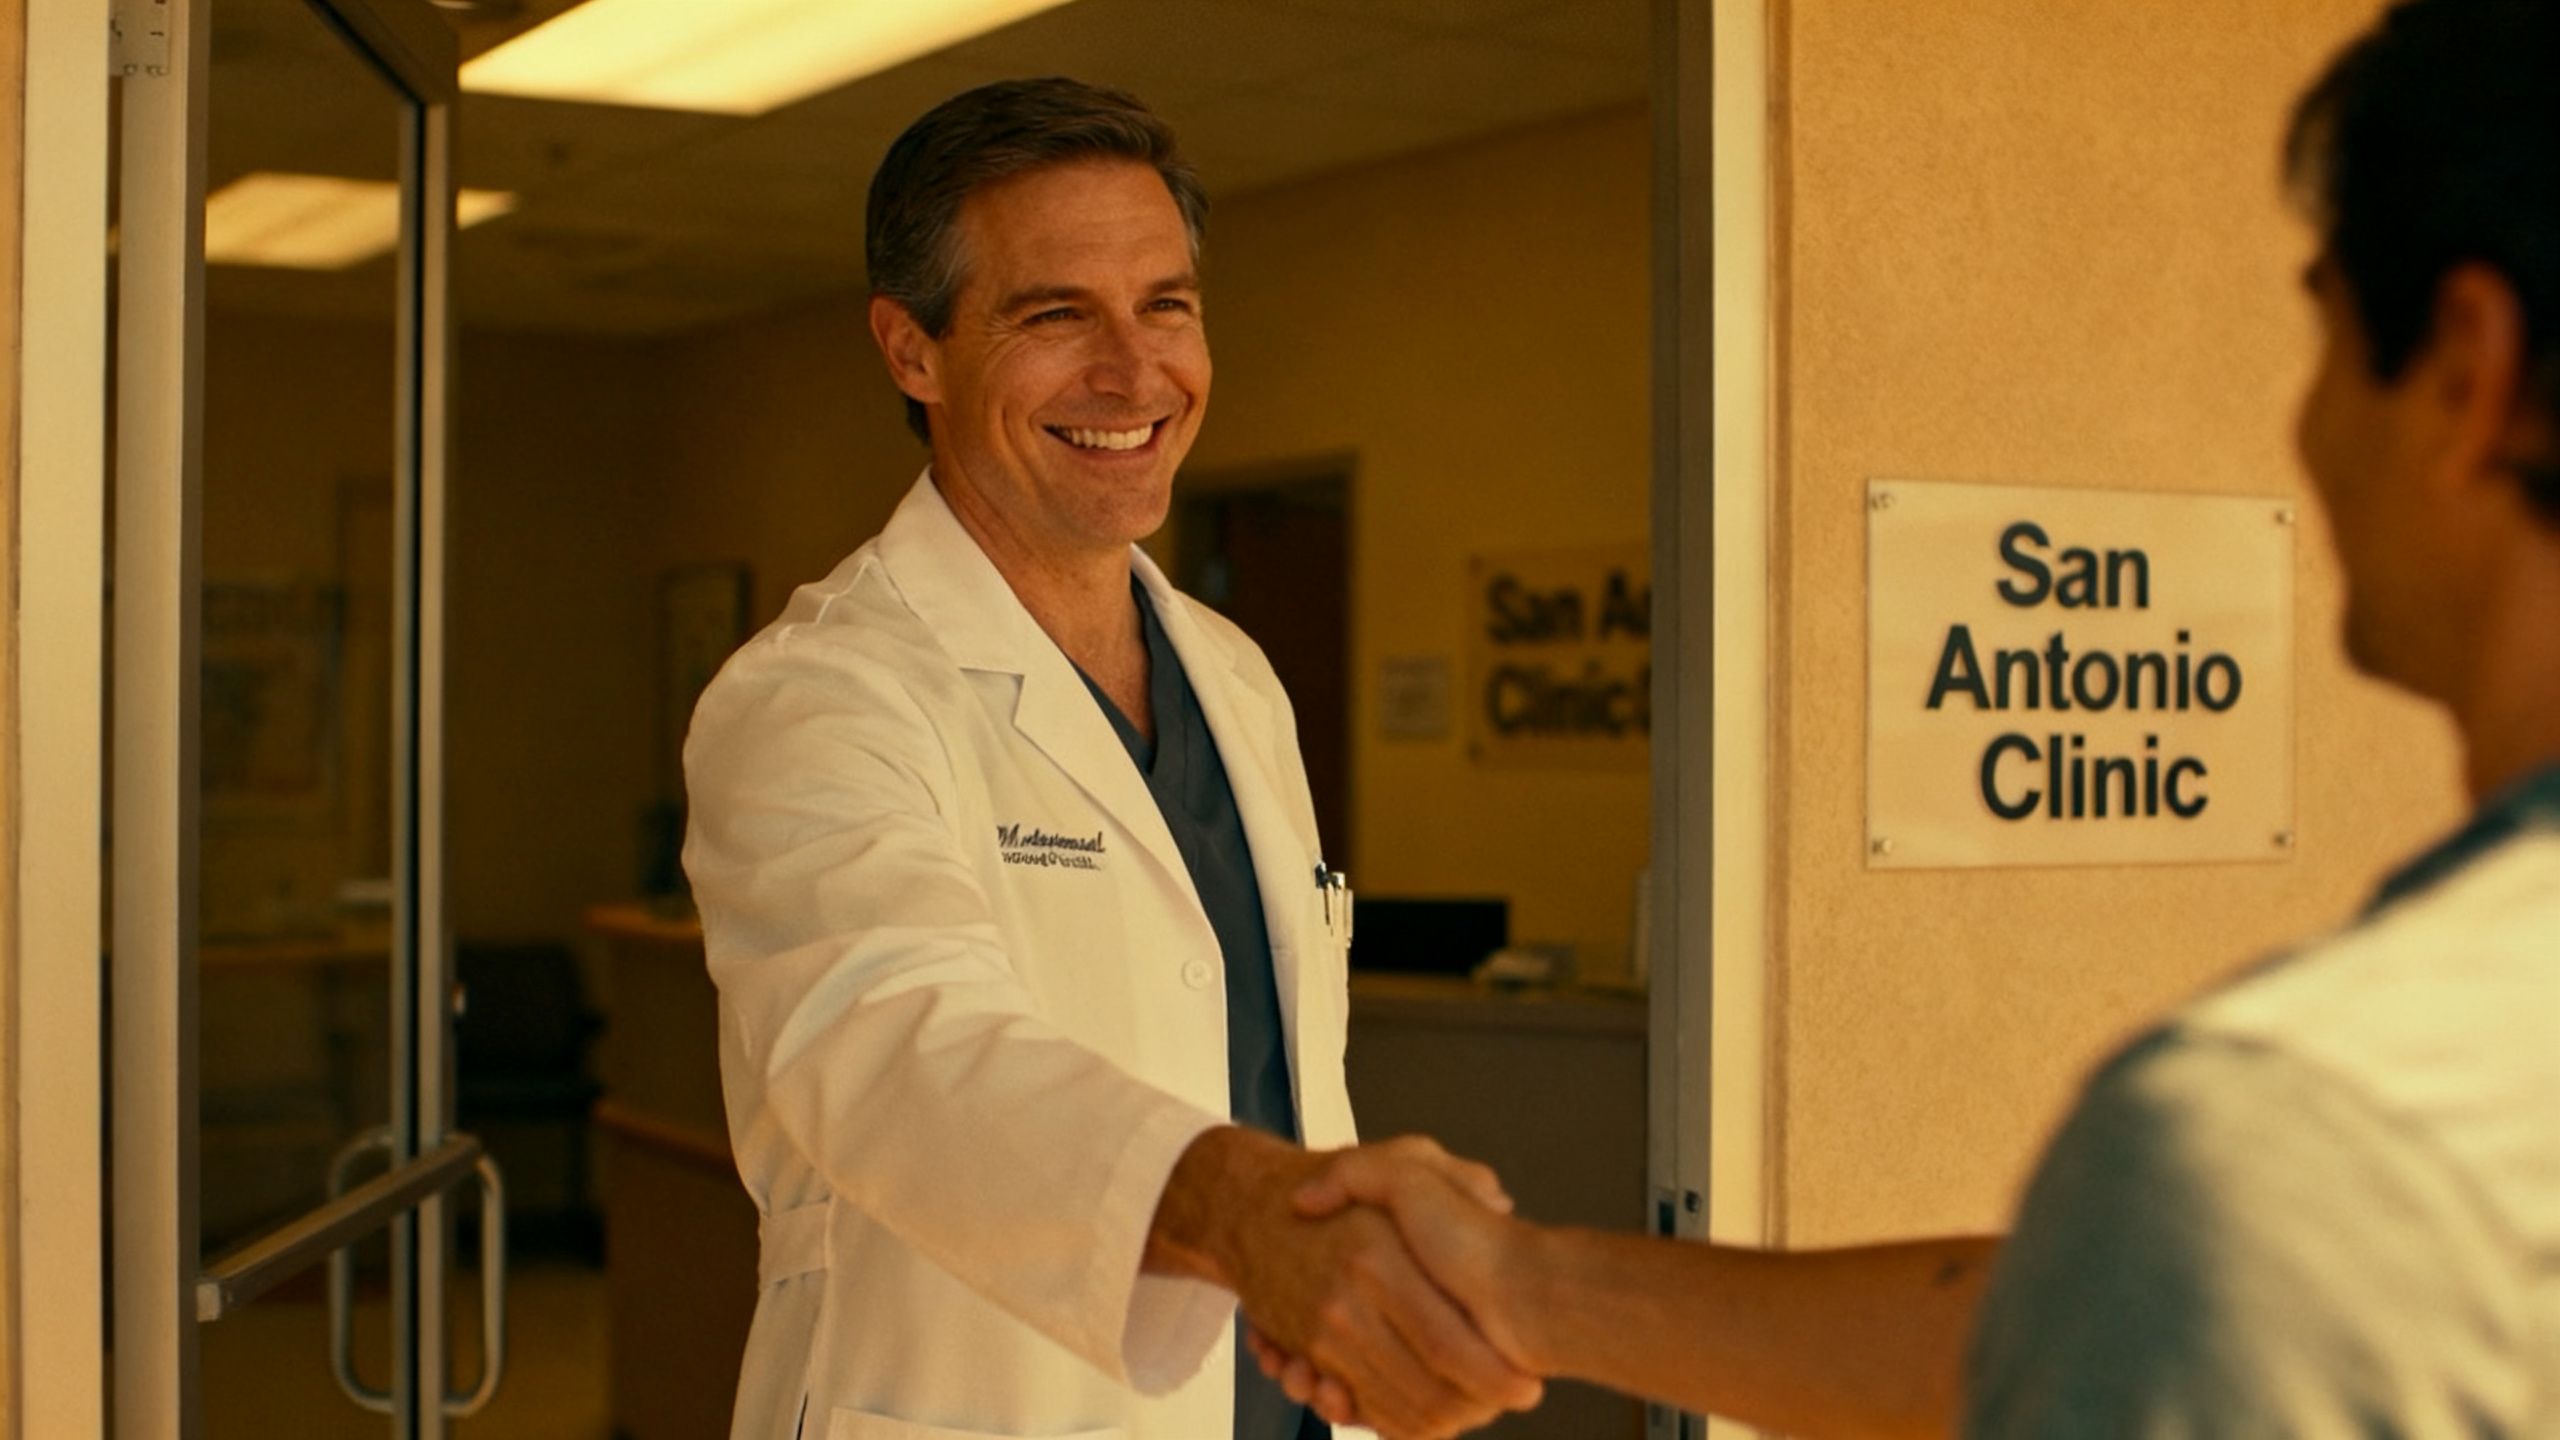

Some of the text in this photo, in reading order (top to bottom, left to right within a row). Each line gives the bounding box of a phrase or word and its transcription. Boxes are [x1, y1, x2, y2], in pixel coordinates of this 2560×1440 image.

[1486, 574, 1584, 642] San
[1996, 521, 2150, 609] San
[1925, 624, 2242, 712] Antonio
[1980, 732, 2209, 821] Clinic
